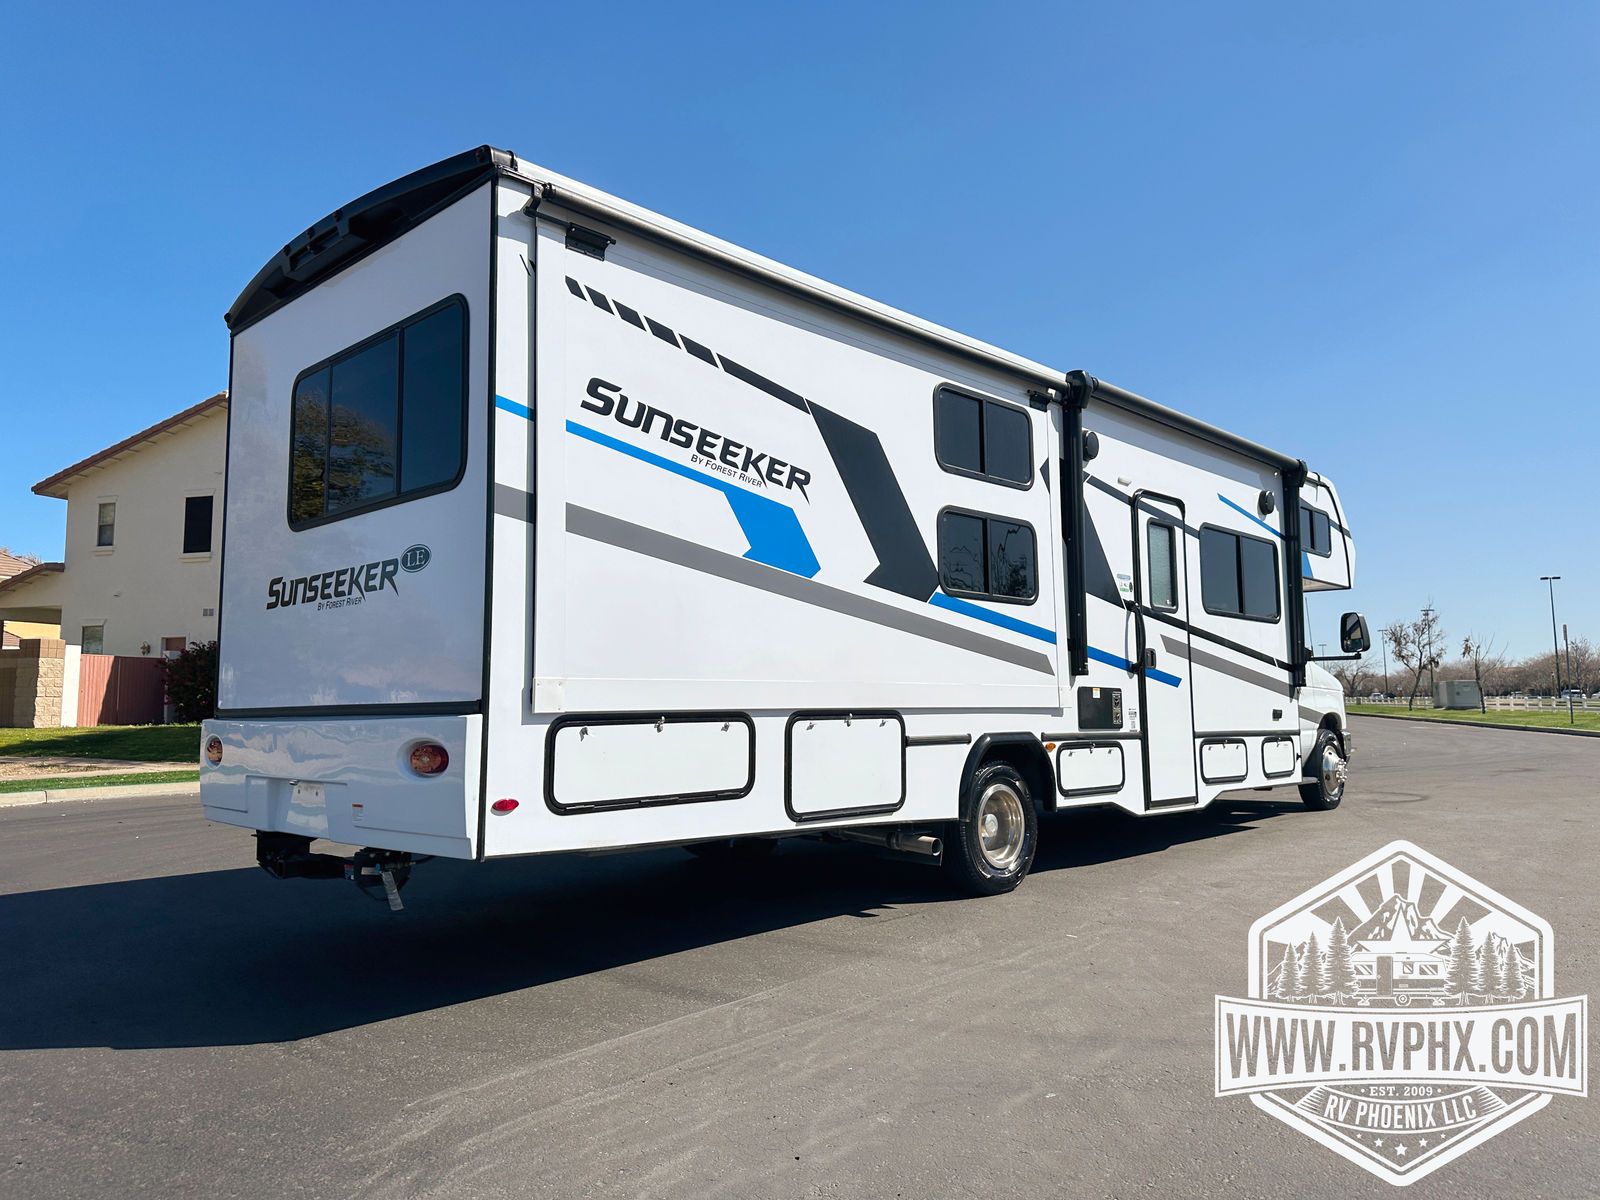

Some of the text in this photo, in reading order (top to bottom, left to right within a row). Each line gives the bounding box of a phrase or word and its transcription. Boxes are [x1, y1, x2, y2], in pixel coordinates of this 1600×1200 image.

[690, 453, 762, 488] BY FOREST RIVER
[406, 549, 425, 567] LE
[325, 599, 346, 610] FOREST
[346, 597, 362, 606] RIVER
